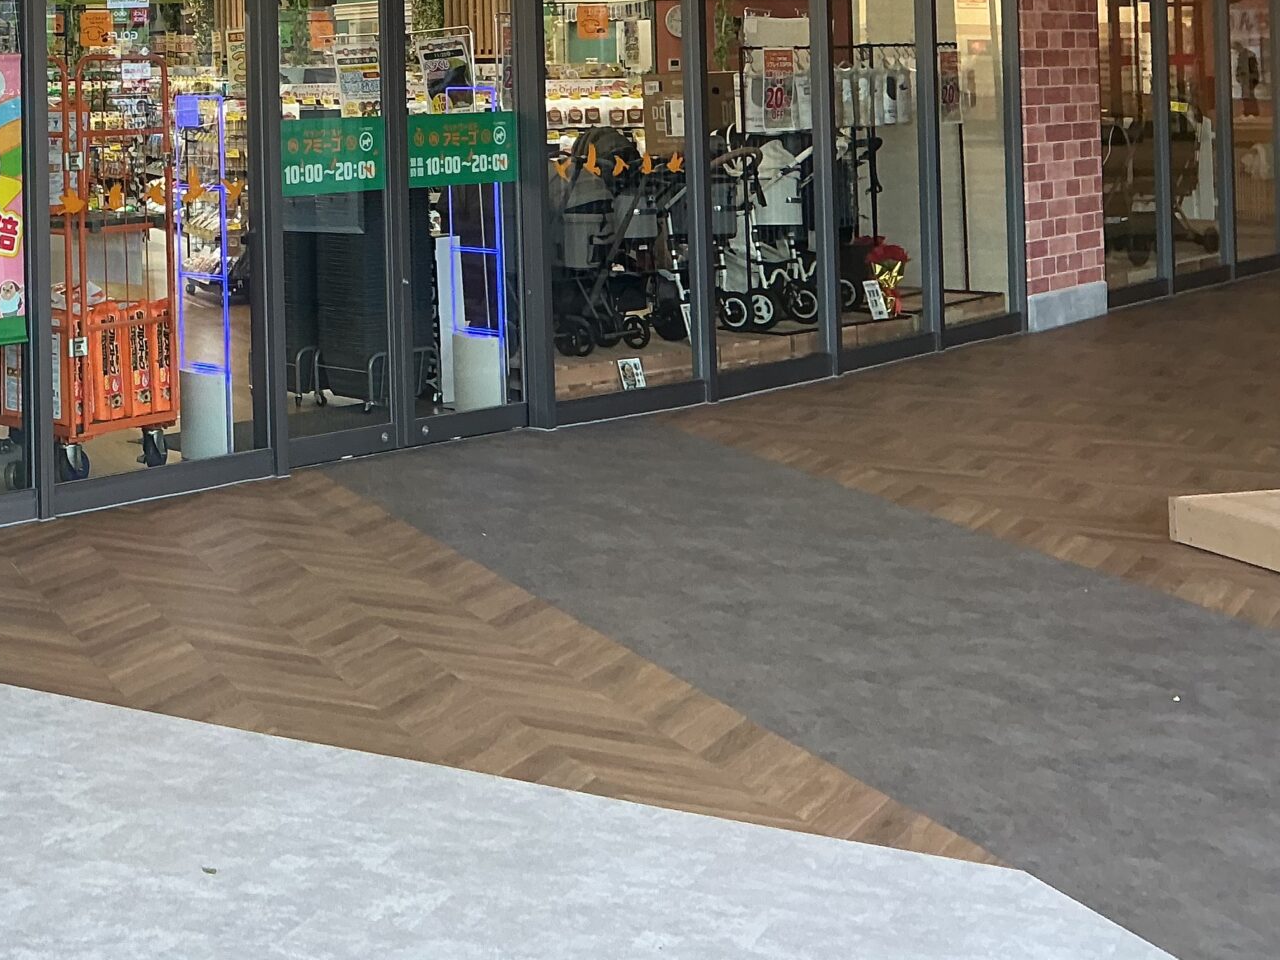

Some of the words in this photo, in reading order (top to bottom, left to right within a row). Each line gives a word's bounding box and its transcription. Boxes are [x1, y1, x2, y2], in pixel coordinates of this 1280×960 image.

[303, 136, 343, 154] アミーゴ
[443, 131, 478, 147] アミーゴ
